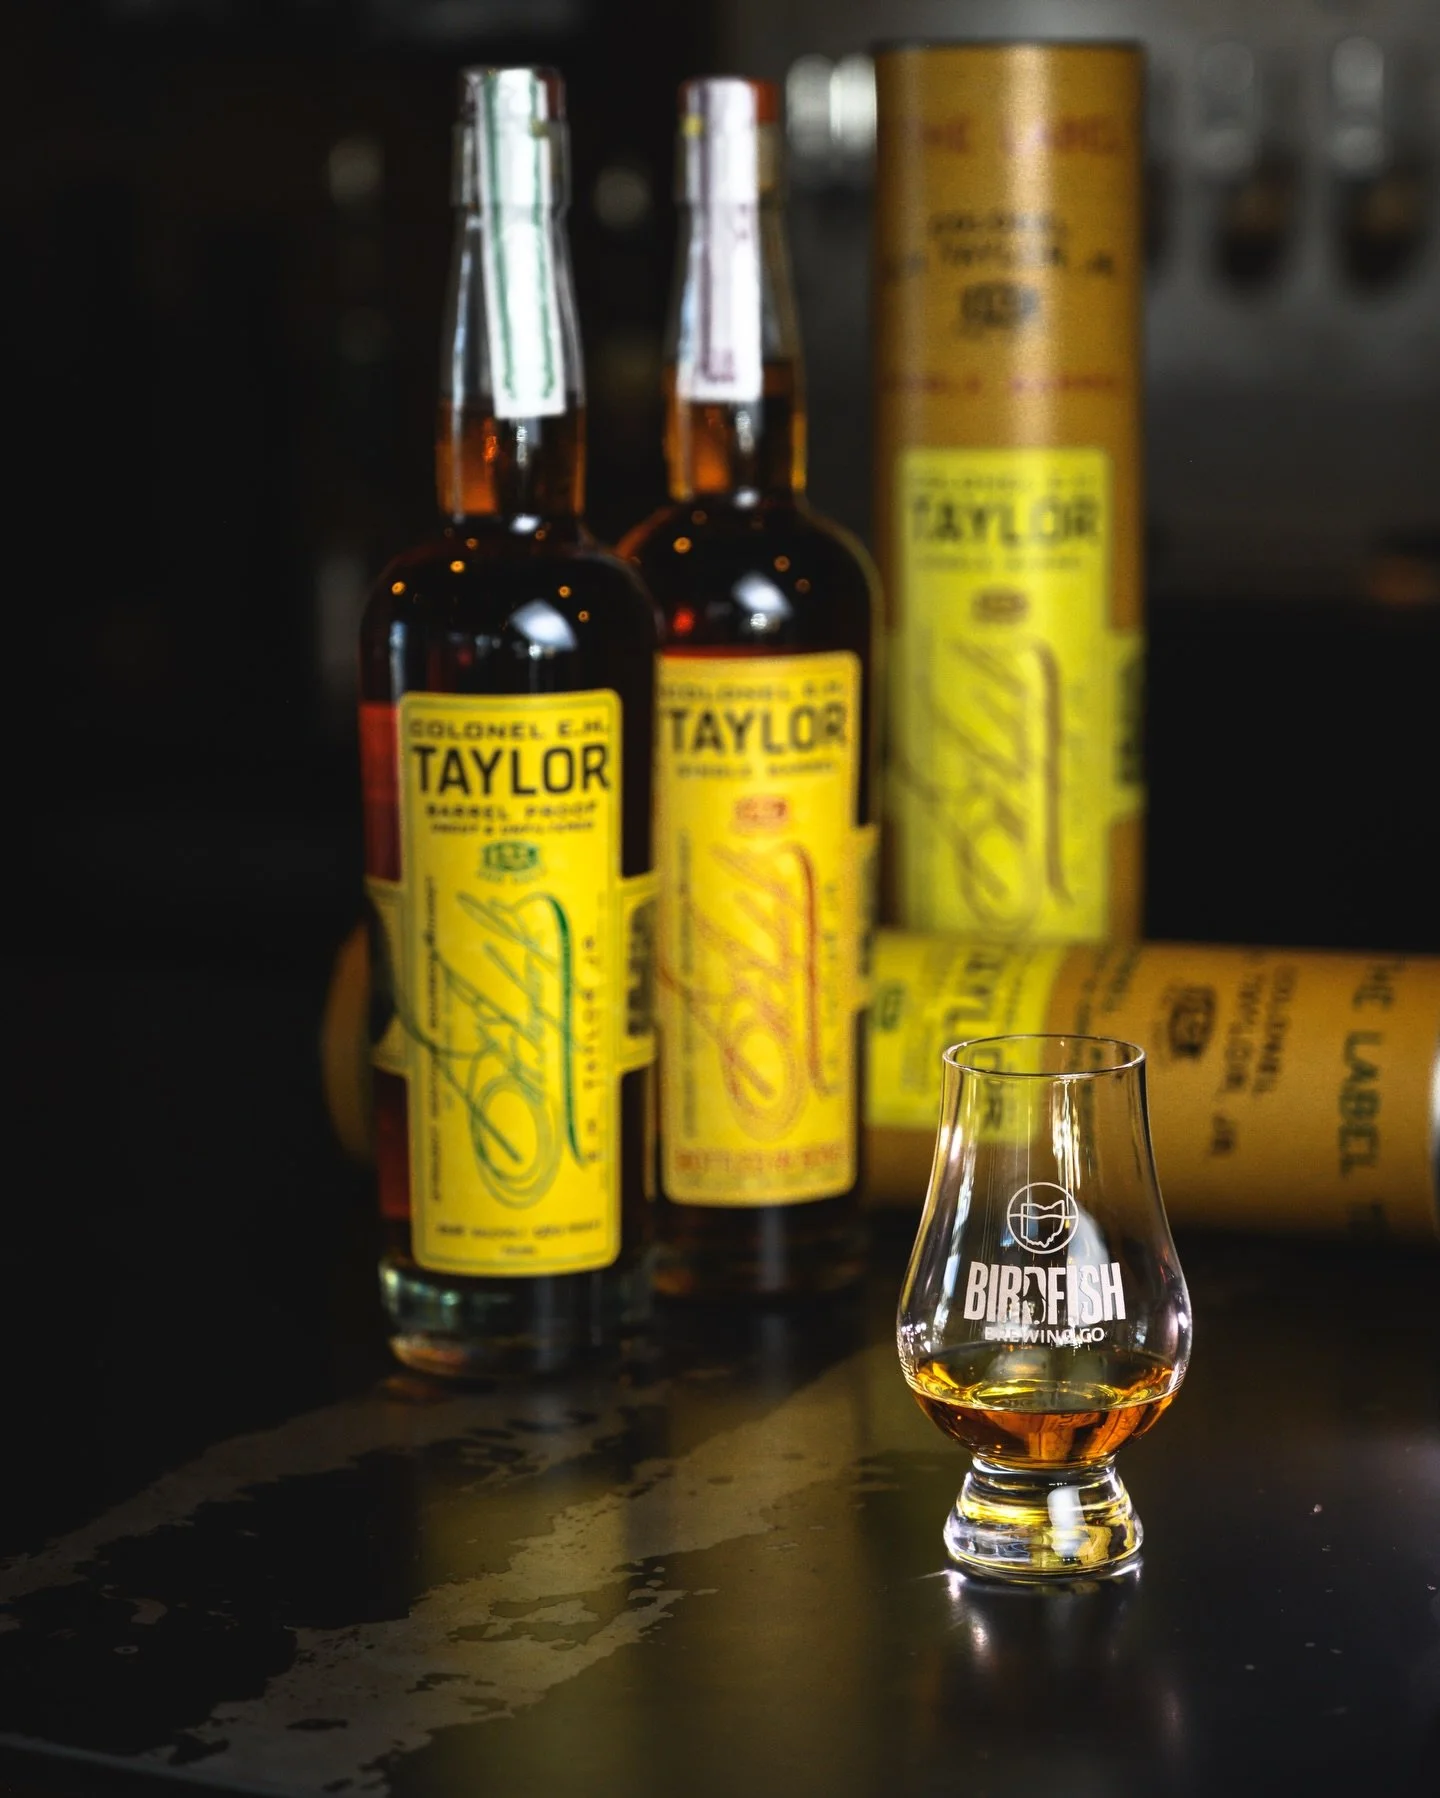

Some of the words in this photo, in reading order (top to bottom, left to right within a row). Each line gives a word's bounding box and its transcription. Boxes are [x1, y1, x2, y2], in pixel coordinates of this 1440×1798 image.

[409, 718, 544, 740] COLONEL
[669, 702, 848, 754] TAYLOR
[411, 743, 611, 796] TAYLOR
[1338, 1030, 1386, 1179] LABEL
[963, 1261, 1126, 1327] BIRDFISH
[984, 1325, 1072, 1344] BREWING
